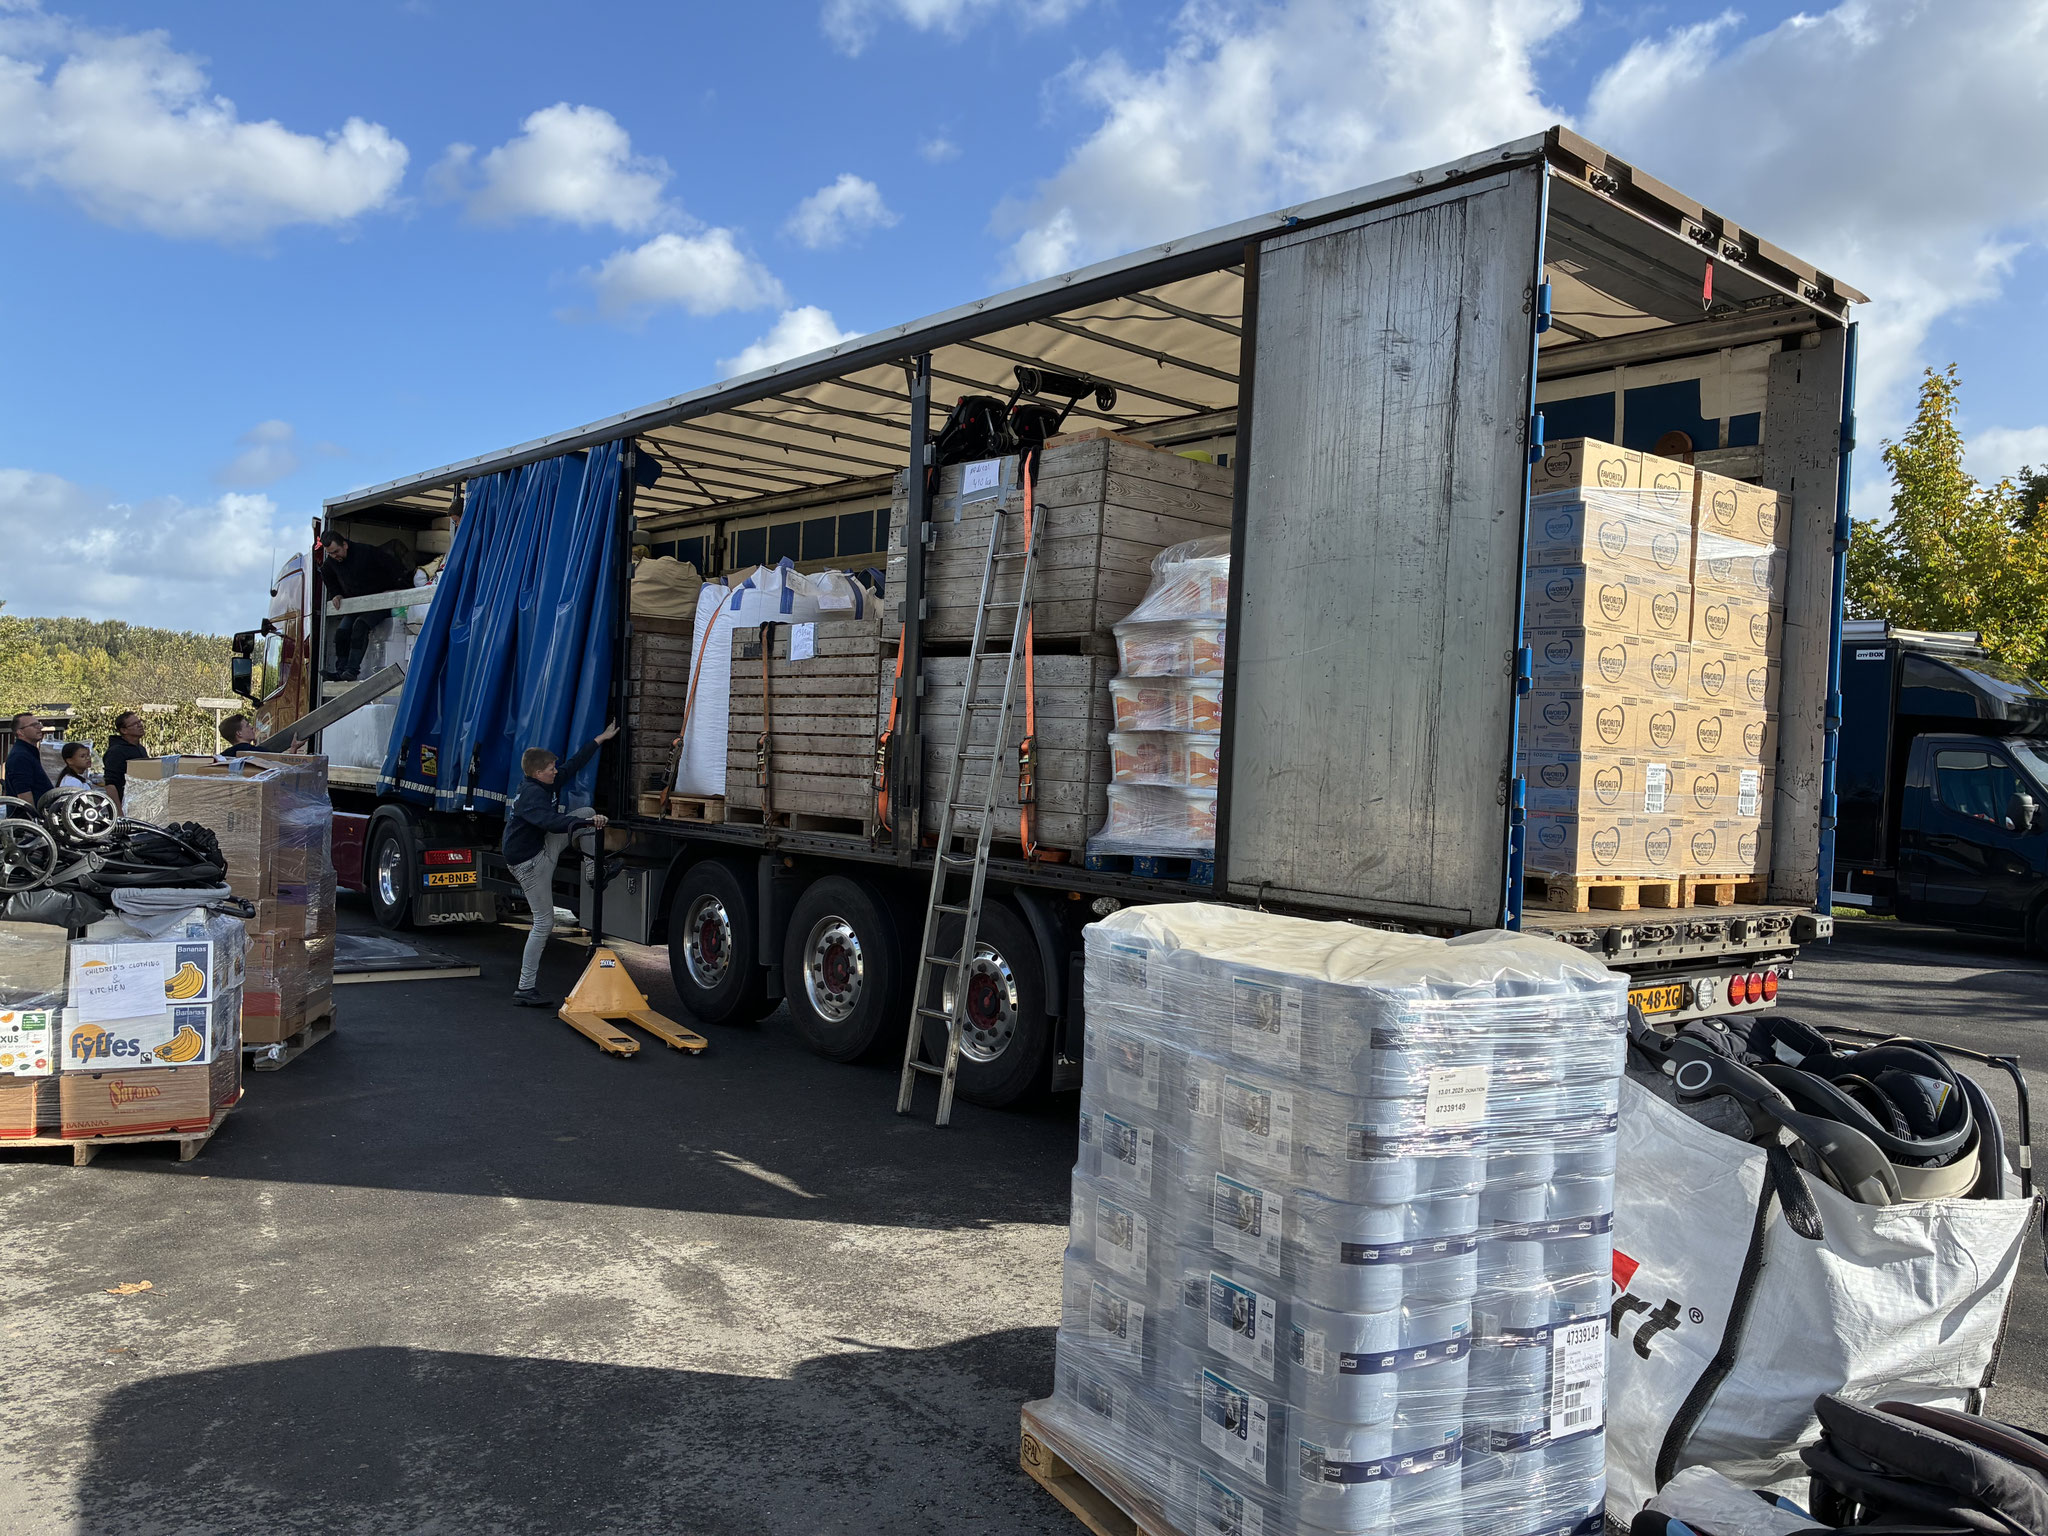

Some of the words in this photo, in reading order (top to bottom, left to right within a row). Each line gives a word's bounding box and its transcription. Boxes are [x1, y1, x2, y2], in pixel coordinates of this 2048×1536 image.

[1600, 469, 1623, 482] FAVORITA
[1602, 594, 1624, 605] FAVORITA
[1655, 603, 1676, 614] FAVORITA
[1708, 615, 1726, 625] FAVORITA
[1601, 657, 1623, 667] FAVORITA
[1654, 663, 1674, 674] FAVORITA
[1704, 672, 1722, 681] FAVORITA
[1600, 718, 1621, 728] FAVORITA
[1652, 723, 1672, 732] FAVORITA
[1700, 728, 1719, 737] FAVORITA
[1597, 779, 1619, 789] FAVORITA
[1696, 786, 1715, 794] FAVORITA
[1595, 841, 1616, 850] FAVORITA
[1648, 841, 1668, 850] FAVORITA
[1694, 842, 1714, 851] FAVORITA
[432, 871, 477, 884] 24-BNB-3
[428, 912, 485, 923] SCANIA
[85, 963, 125, 976] CHILDREN'S
[128, 960, 160, 968] CLOTHING
[112, 974, 121, 984] &
[89, 984, 126, 995] KITCHEN
[175, 1009, 205, 1017] Bananas
[0, 1035, 19, 1043] XUS
[71, 1032, 140, 1064] fyffes
[1438, 1087, 1464, 1096] 13.01.2025
[1435, 1103, 1466, 1113] 47339149
[65, 1119, 109, 1129] BANANAS
[1566, 1326, 1600, 1346] 47339149
[1023, 1437, 1040, 1463] EPAL
[1325, 1468, 1340, 1476] TORK
